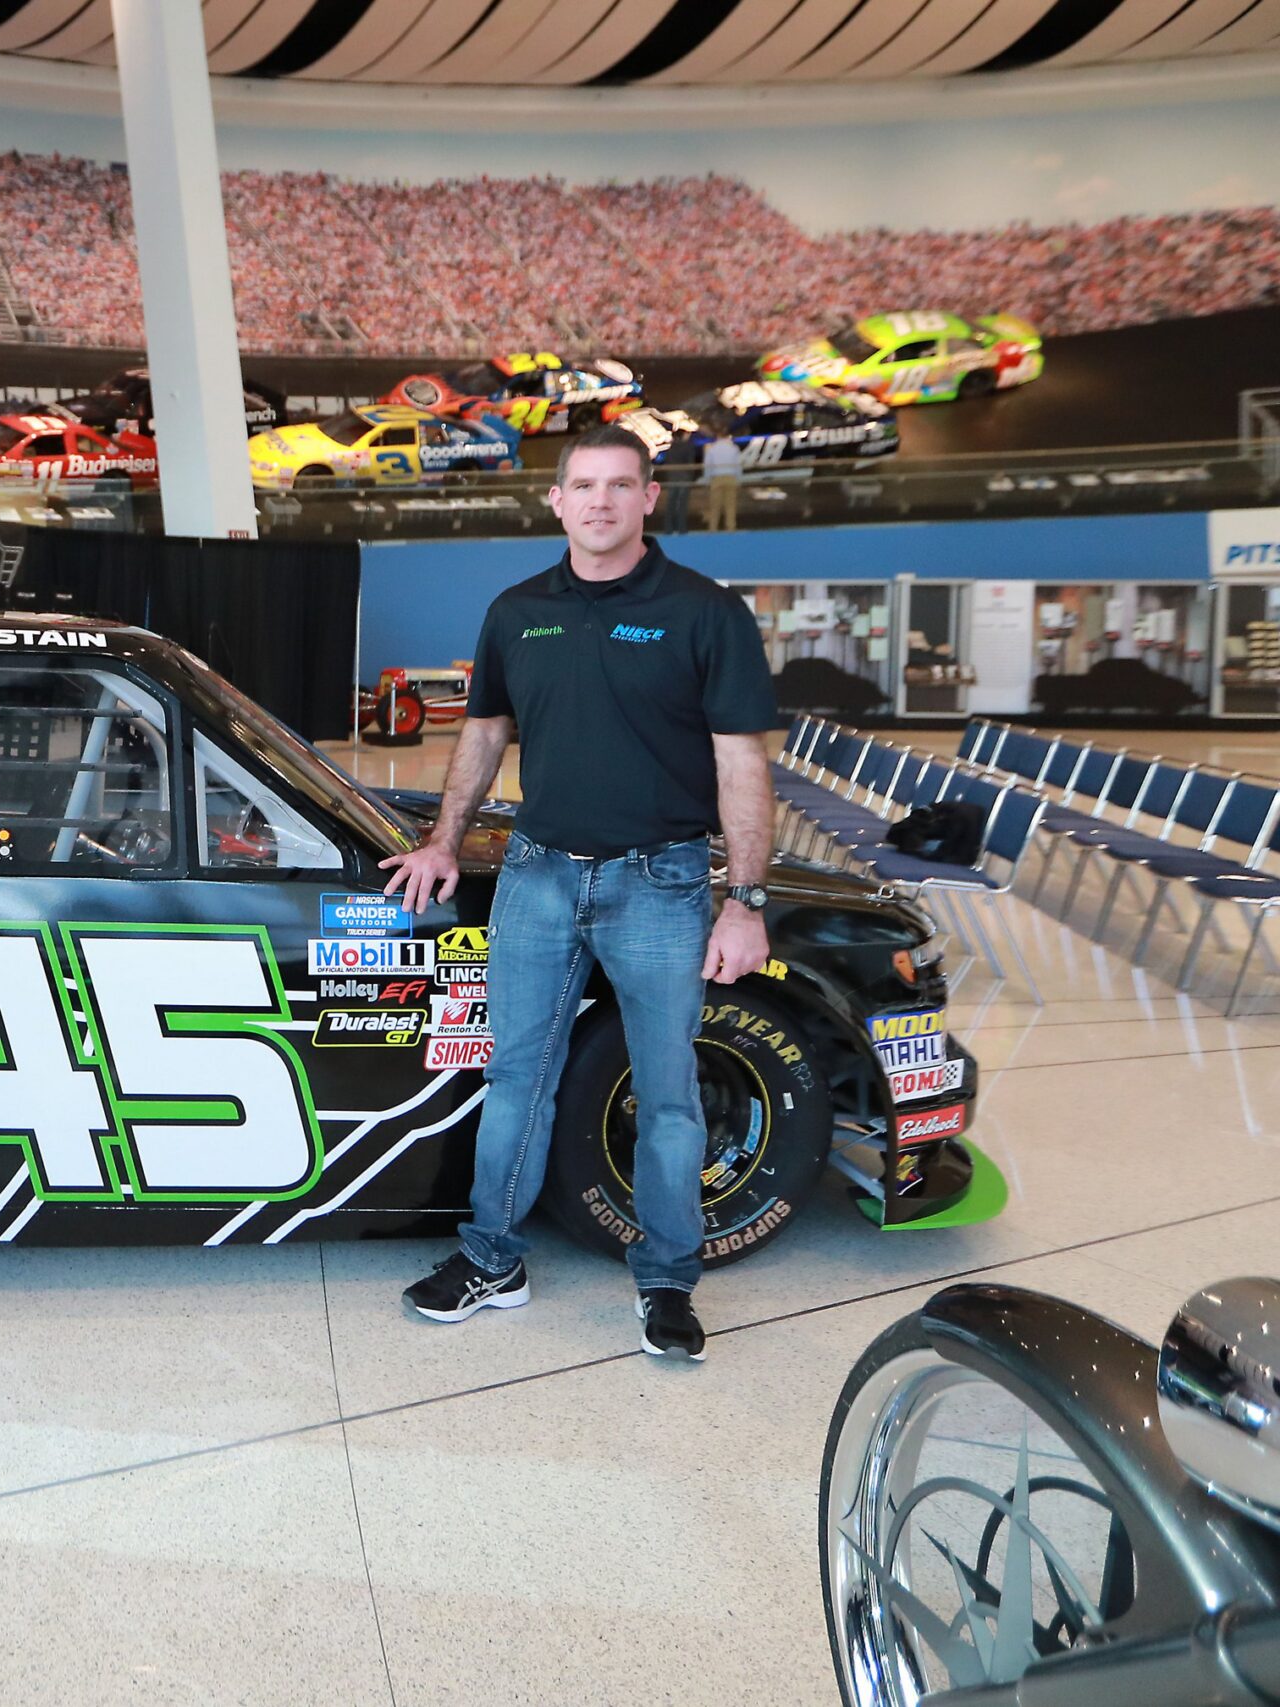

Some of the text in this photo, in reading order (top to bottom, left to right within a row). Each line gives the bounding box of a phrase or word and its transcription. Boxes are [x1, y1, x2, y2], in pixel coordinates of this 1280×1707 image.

[740, 434, 788, 467] 48
[376, 452, 415, 476] 3
[613, 623, 666, 640] NIECE
[355, 896, 386, 904] NASCAR
[335, 906, 397, 919] GANDER
[346, 928, 387, 936] TRUCK SERIES
[316, 942, 393, 966] Mobil
[437, 949, 488, 961] MECHAN
[440, 967, 488, 983] LINC
[320, 980, 428, 1004] Holley EFI
[326, 1012, 420, 1031] Duralast
[437, 1026, 471, 1034] Renton
[385, 1030, 416, 1044] GT
[701, 1004, 802, 1066] DYEAR
[432, 1041, 494, 1065] SIMPS
[899, 1111, 960, 1141] Edelbrock
[703, 1199, 792, 1260] SUPPORT
